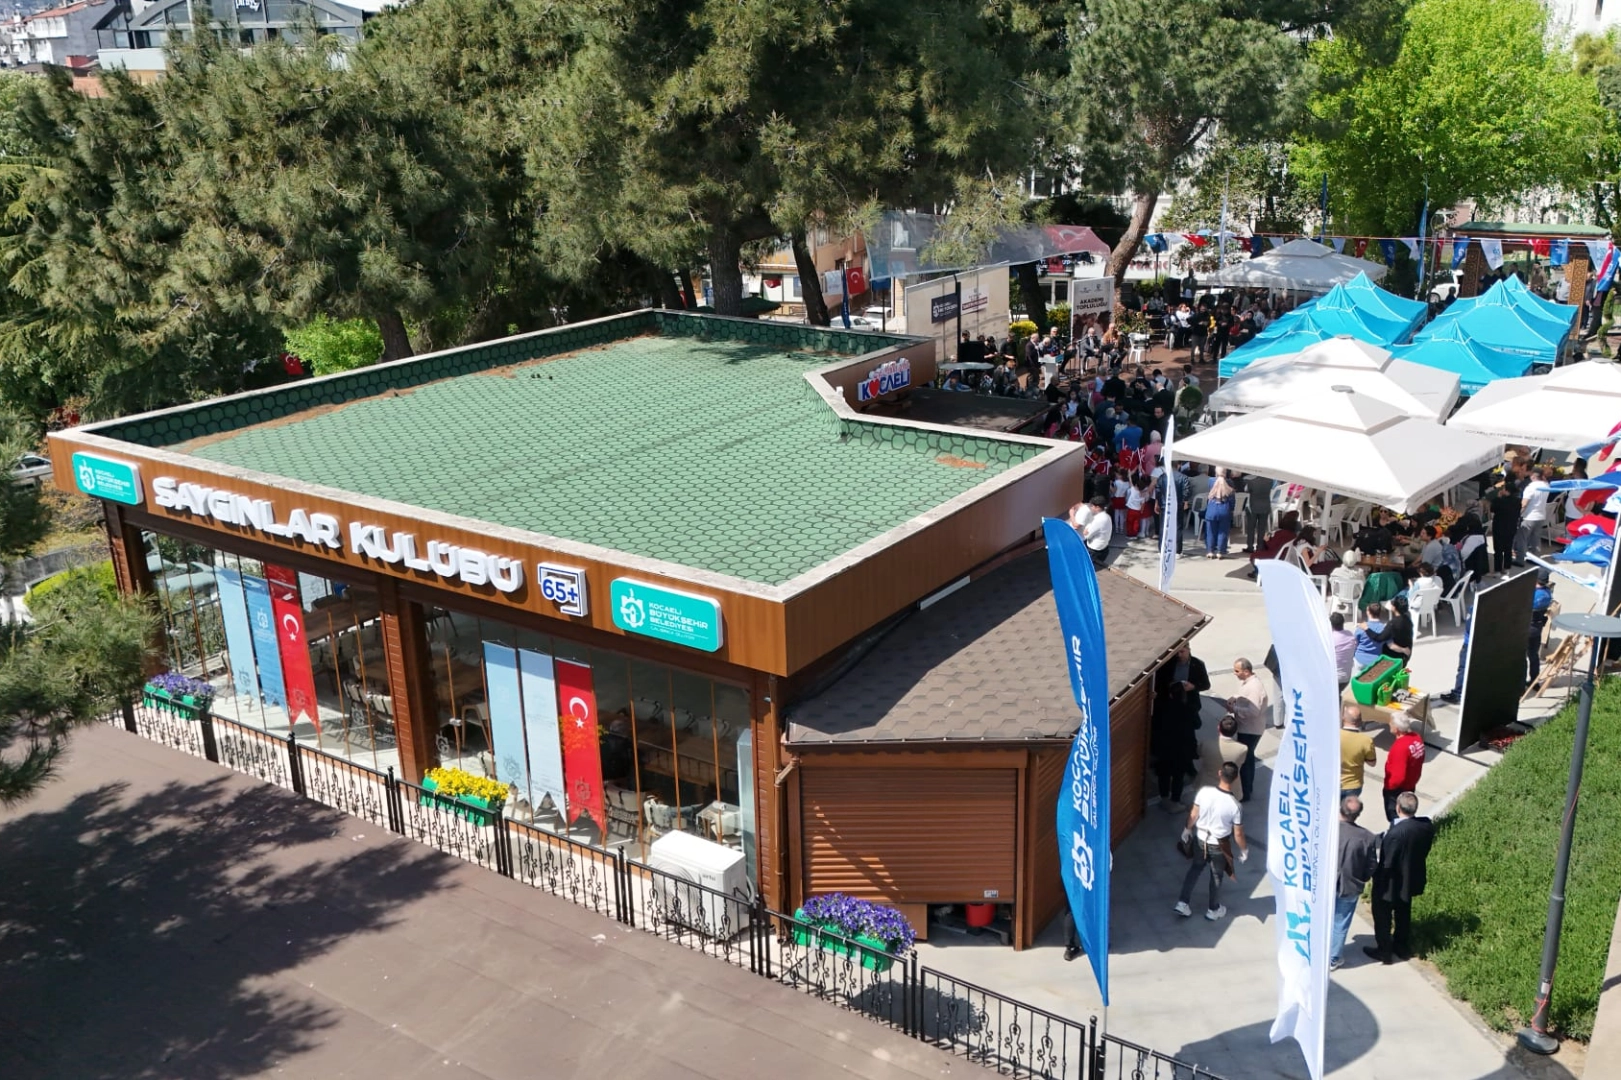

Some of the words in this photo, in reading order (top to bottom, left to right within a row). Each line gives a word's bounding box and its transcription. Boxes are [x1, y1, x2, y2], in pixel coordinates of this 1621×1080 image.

[153, 476, 342, 549] SAYGINLAR
[349, 521, 523, 593] KULÜBÜ
[542, 578, 578, 602] 65+
[1071, 634, 1092, 823] BÜYÜKİR
